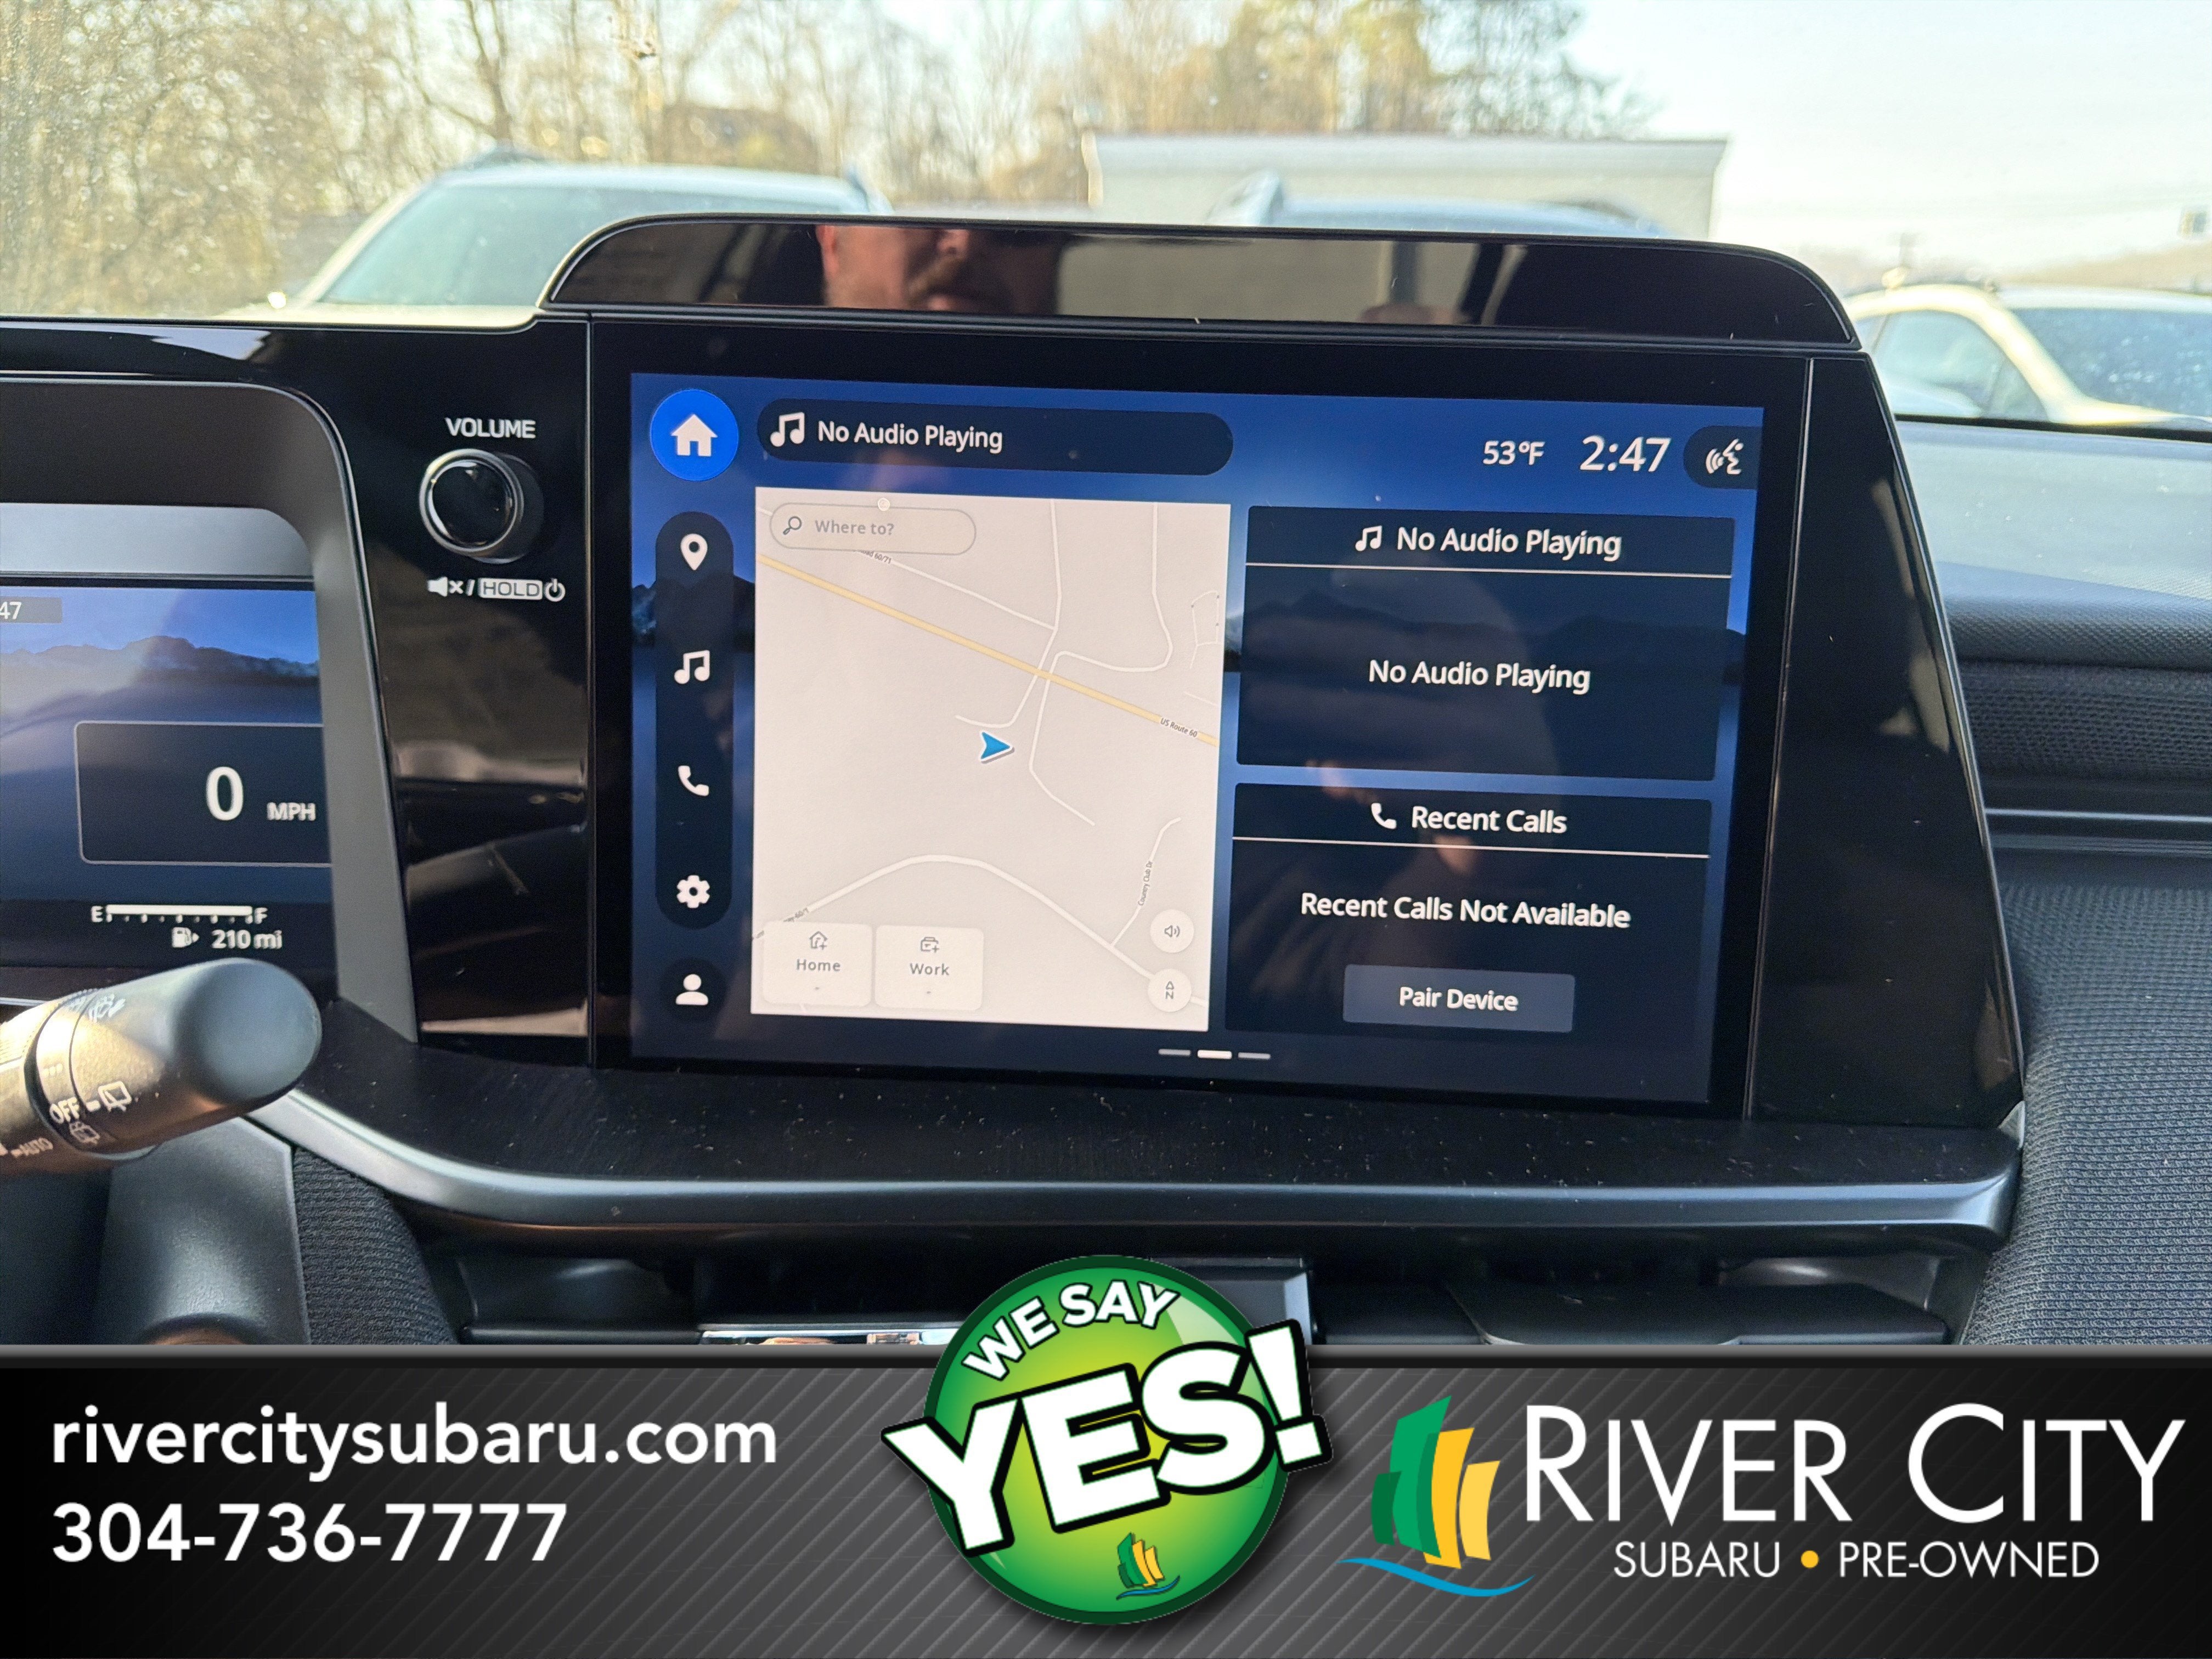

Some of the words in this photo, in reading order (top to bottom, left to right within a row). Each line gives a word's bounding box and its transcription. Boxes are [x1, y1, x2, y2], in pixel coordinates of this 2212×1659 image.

[445, 417, 537, 439] VOLUME
[818, 420, 850, 442] No
[854, 422, 919, 445] Audio
[926, 424, 1003, 454] Playing
[1482, 440, 1545, 466] 53°F
[1579, 435, 1671, 472] 2:47
[815, 519, 866, 535] Where
[870, 522, 895, 535] to?
[1397, 527, 1435, 551] No
[1440, 527, 1519, 553] Audio
[1526, 529, 1622, 562] Playing
[483, 582, 540, 597] HOLD
[1368, 659, 1407, 684] No
[1410, 661, 1489, 686] Audio
[1496, 662, 1591, 696] Playing
[1160, 718, 1170, 726] US
[1170, 721, 1188, 734] Route
[1189, 729, 1198, 737] 60
[206, 766, 244, 821] 0
[267, 802, 316, 821] MPH
[1411, 805, 1501, 832] Recent
[1506, 809, 1567, 834] Calls
[1143, 869, 1151, 882] Club
[1138, 883, 1150, 906] Country
[91, 905, 104, 923] E
[255, 907, 268, 924] F
[1301, 891, 1389, 918] Recent
[1393, 896, 1453, 921] Calls
[1459, 899, 1509, 924] Not
[1511, 901, 1632, 929] Available
[212, 929, 251, 949] 210
[253, 929, 283, 949] mi
[796, 958, 842, 972] Home
[909, 963, 950, 976] Work
[1165, 991, 1174, 1000] N
[1399, 986, 1443, 1008] Pair
[1446, 988, 1519, 1012] Device
[50, 1097, 80, 1124] OFF
